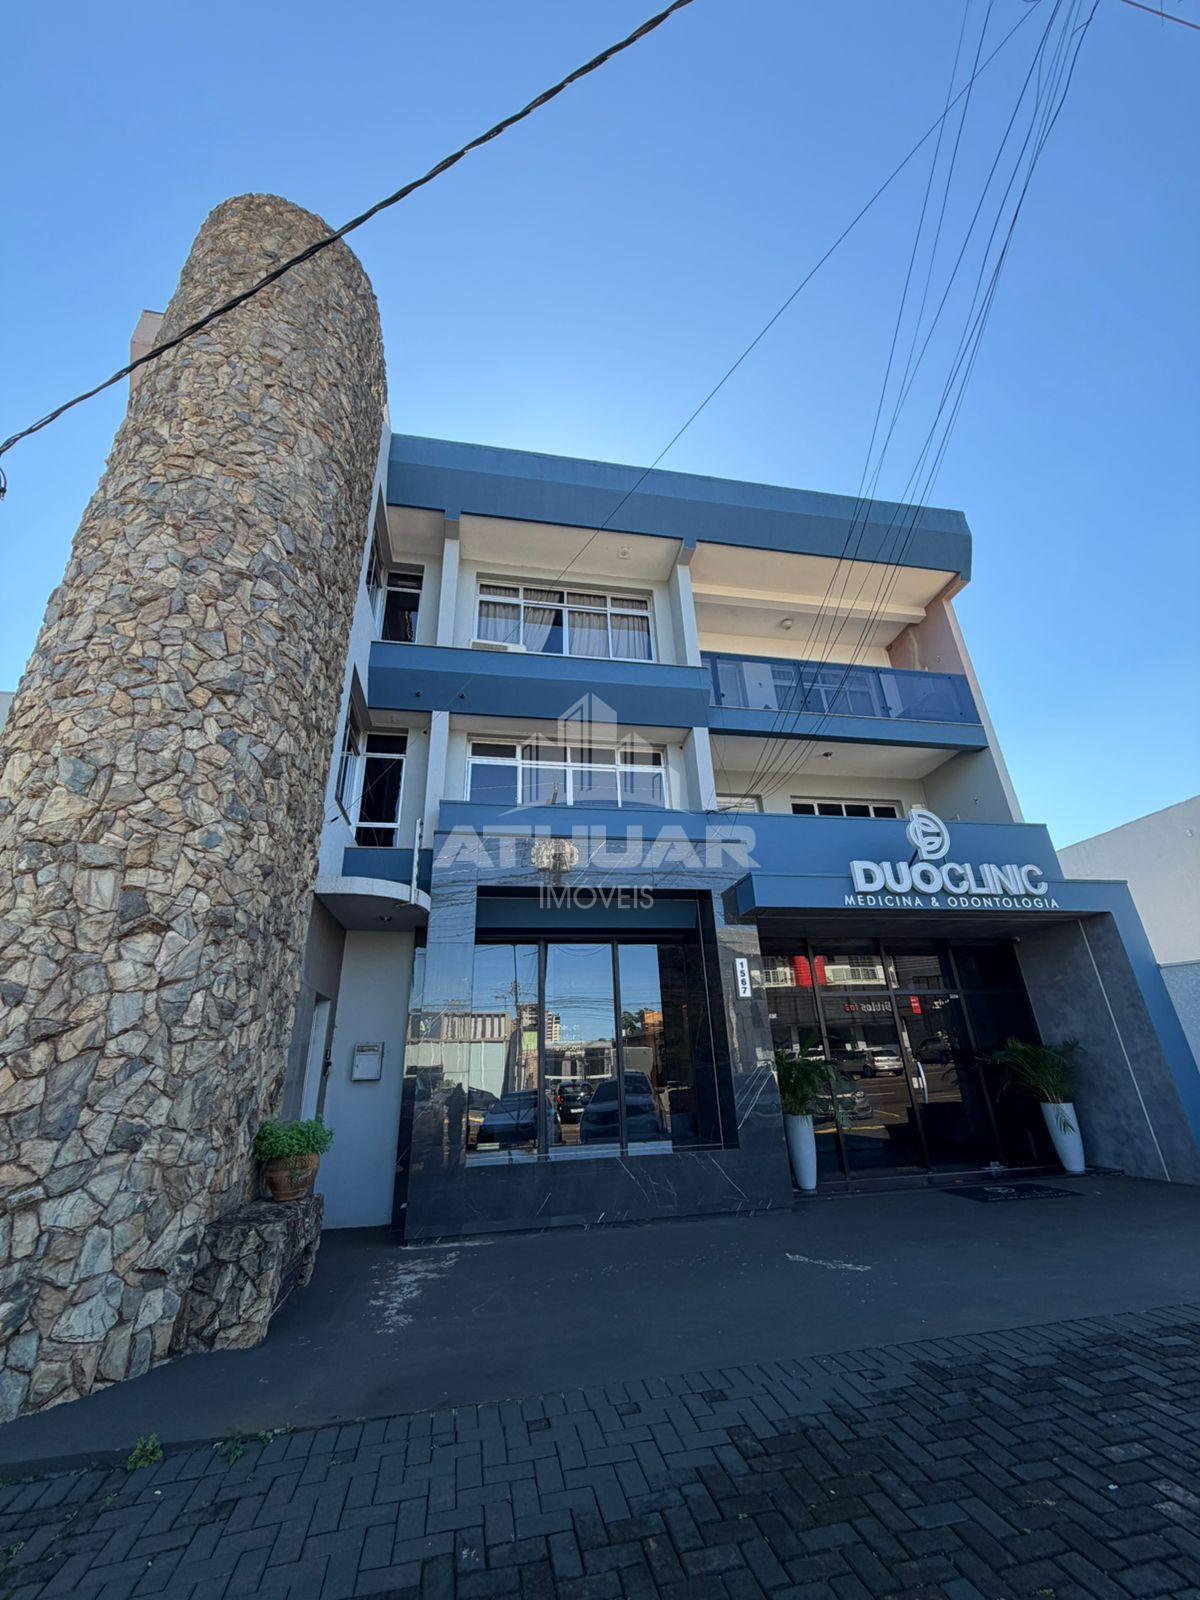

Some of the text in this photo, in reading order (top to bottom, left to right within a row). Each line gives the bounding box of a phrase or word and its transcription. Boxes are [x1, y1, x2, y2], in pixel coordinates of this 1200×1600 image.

[849, 860, 1049, 896] DUOCLINIC
[844, 895, 1060, 909] MEDICINA & ODONTOLOGIA
[739, 961, 748, 994] 1567
